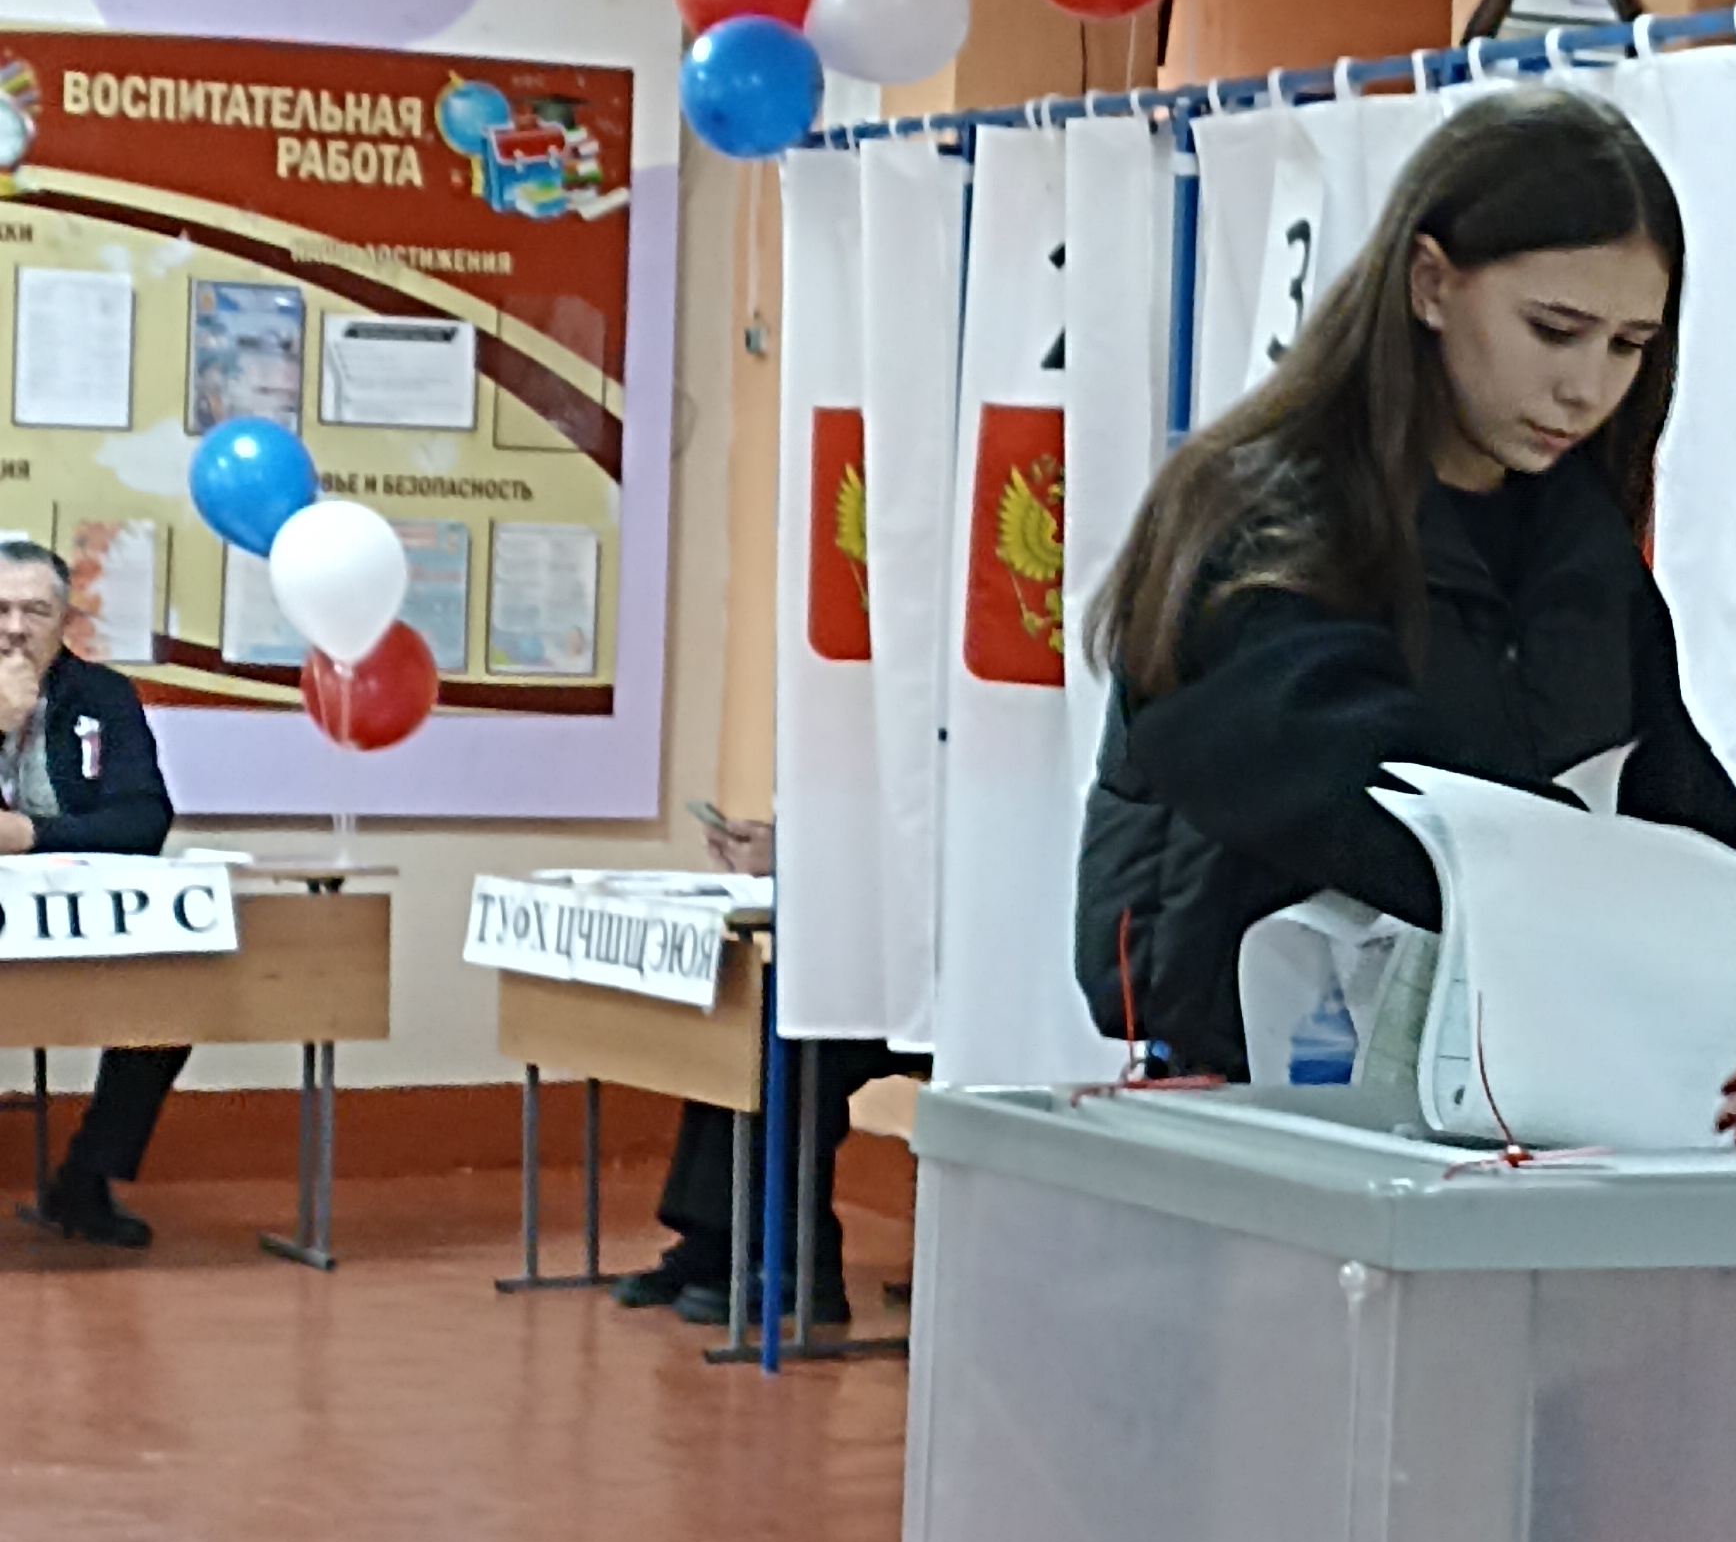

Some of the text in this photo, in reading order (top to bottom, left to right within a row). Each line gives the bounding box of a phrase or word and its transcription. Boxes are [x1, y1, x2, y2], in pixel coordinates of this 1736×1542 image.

[62, 69, 423, 138] ВОСПИТАТЕЛЬНАЯ
[276, 135, 423, 188] РАБОТА
[382, 473, 534, 501] БЕЗОПАСНОСТЬ
